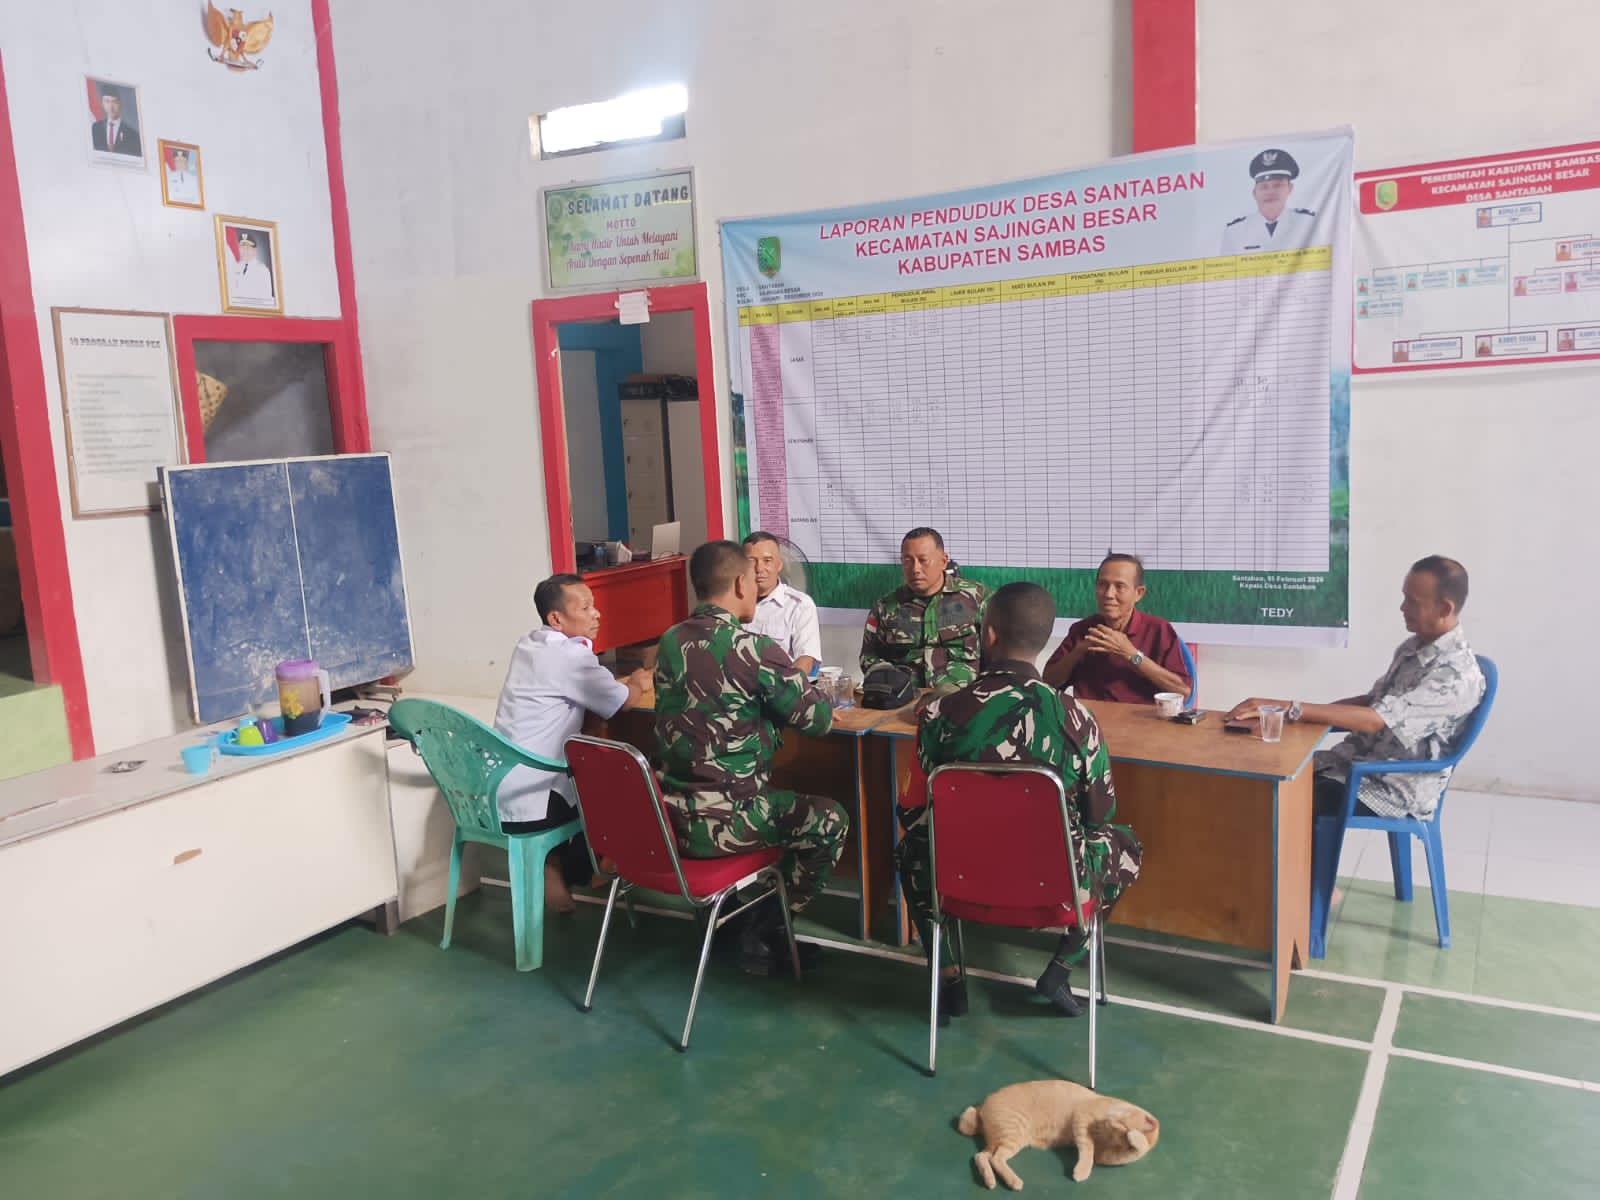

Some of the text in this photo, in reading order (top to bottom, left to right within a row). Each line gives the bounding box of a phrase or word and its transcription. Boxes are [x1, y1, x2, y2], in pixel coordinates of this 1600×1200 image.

[1421, 168, 1486, 184] PEMERINTAH
[1488, 160, 1552, 176] KABUPATEN
[1431, 167, 1590, 196] KECAMATAN SAJINGAN BESAR
[568, 185, 690, 216] SELAMAT DATANG
[819, 171, 1206, 240] LAPORAN PENDUDUK DESA SANTABAN
[1465, 184, 1553, 203] DESA SANTABAN
[606, 217, 637, 231] MOTTO
[855, 202, 1159, 258] KECAMATAN SAJINGAN BESAR
[642, 229, 679, 247] Melayani
[898, 233, 1106, 276] KABUPATEN SAMBAS
[1261, 607, 1294, 618] TEDY
